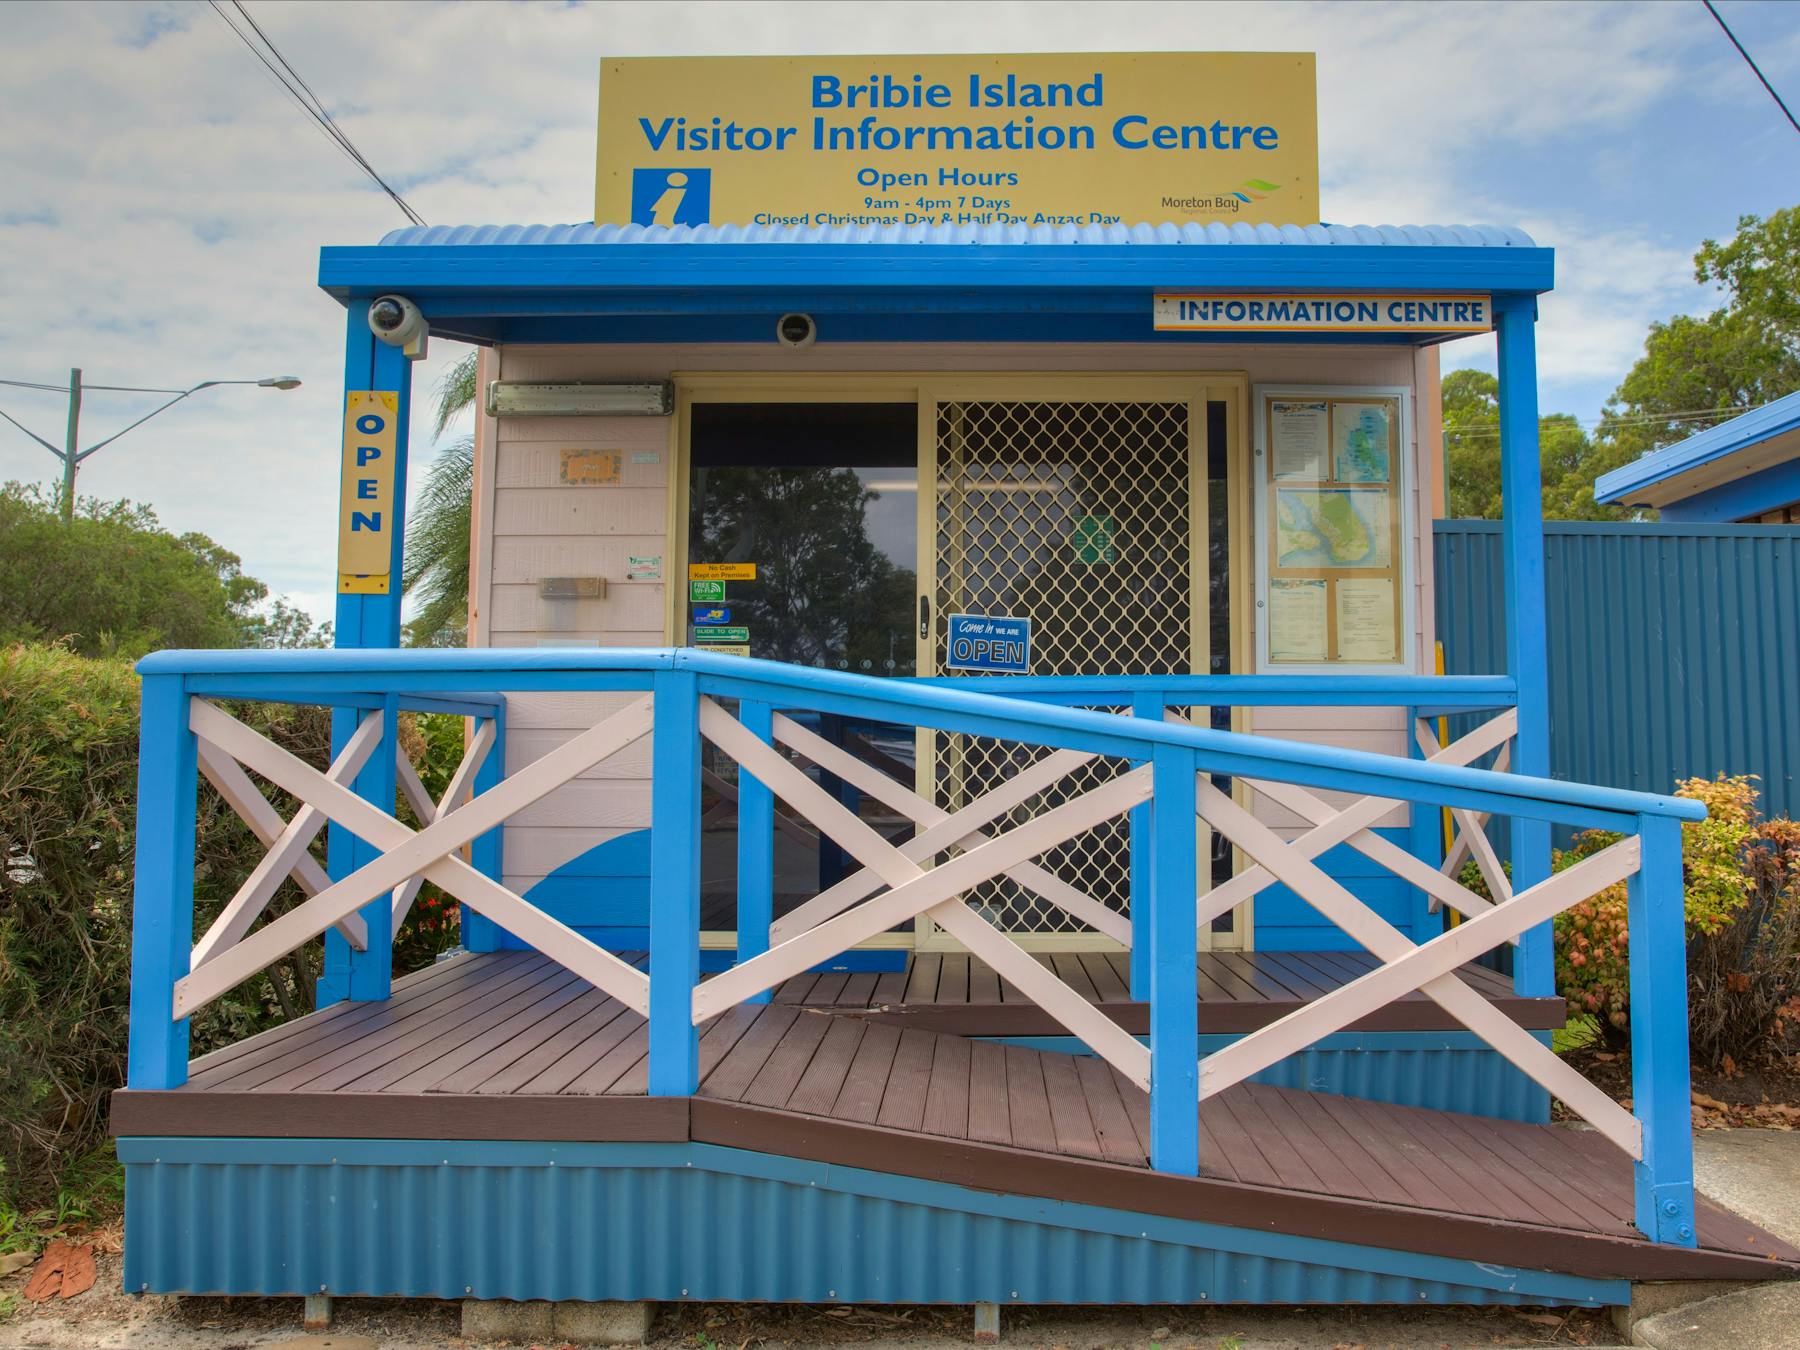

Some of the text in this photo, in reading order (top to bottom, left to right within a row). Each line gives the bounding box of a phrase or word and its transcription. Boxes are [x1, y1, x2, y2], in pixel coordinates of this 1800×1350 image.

[812, 73, 1103, 109] Bribie Island
[638, 115, 1279, 151] Visitor Information Centre
[857, 167, 1019, 191] Open Hours
[864, 197, 899, 209] 9am
[915, 197, 951, 212] 4pm
[957, 196, 966, 209] 7
[972, 196, 1011, 212] Days
[1161, 196, 1239, 213] Moreton Bay
[753, 213, 809, 225] Closed
[814, 213, 899, 225] Christmas
[904, 213, 936, 225] Day
[941, 212, 953, 224] &
[958, 212, 993, 224] Half
[1033, 212, 1084, 224] Anzac
[1089, 212, 1121, 224] Day
[1179, 300, 1483, 322] INFORMATION CENTRE
[351, 414, 386, 532] OPEN
[959, 620, 1020, 636] Come in WE ARE
[953, 637, 1025, 665] OPEN
